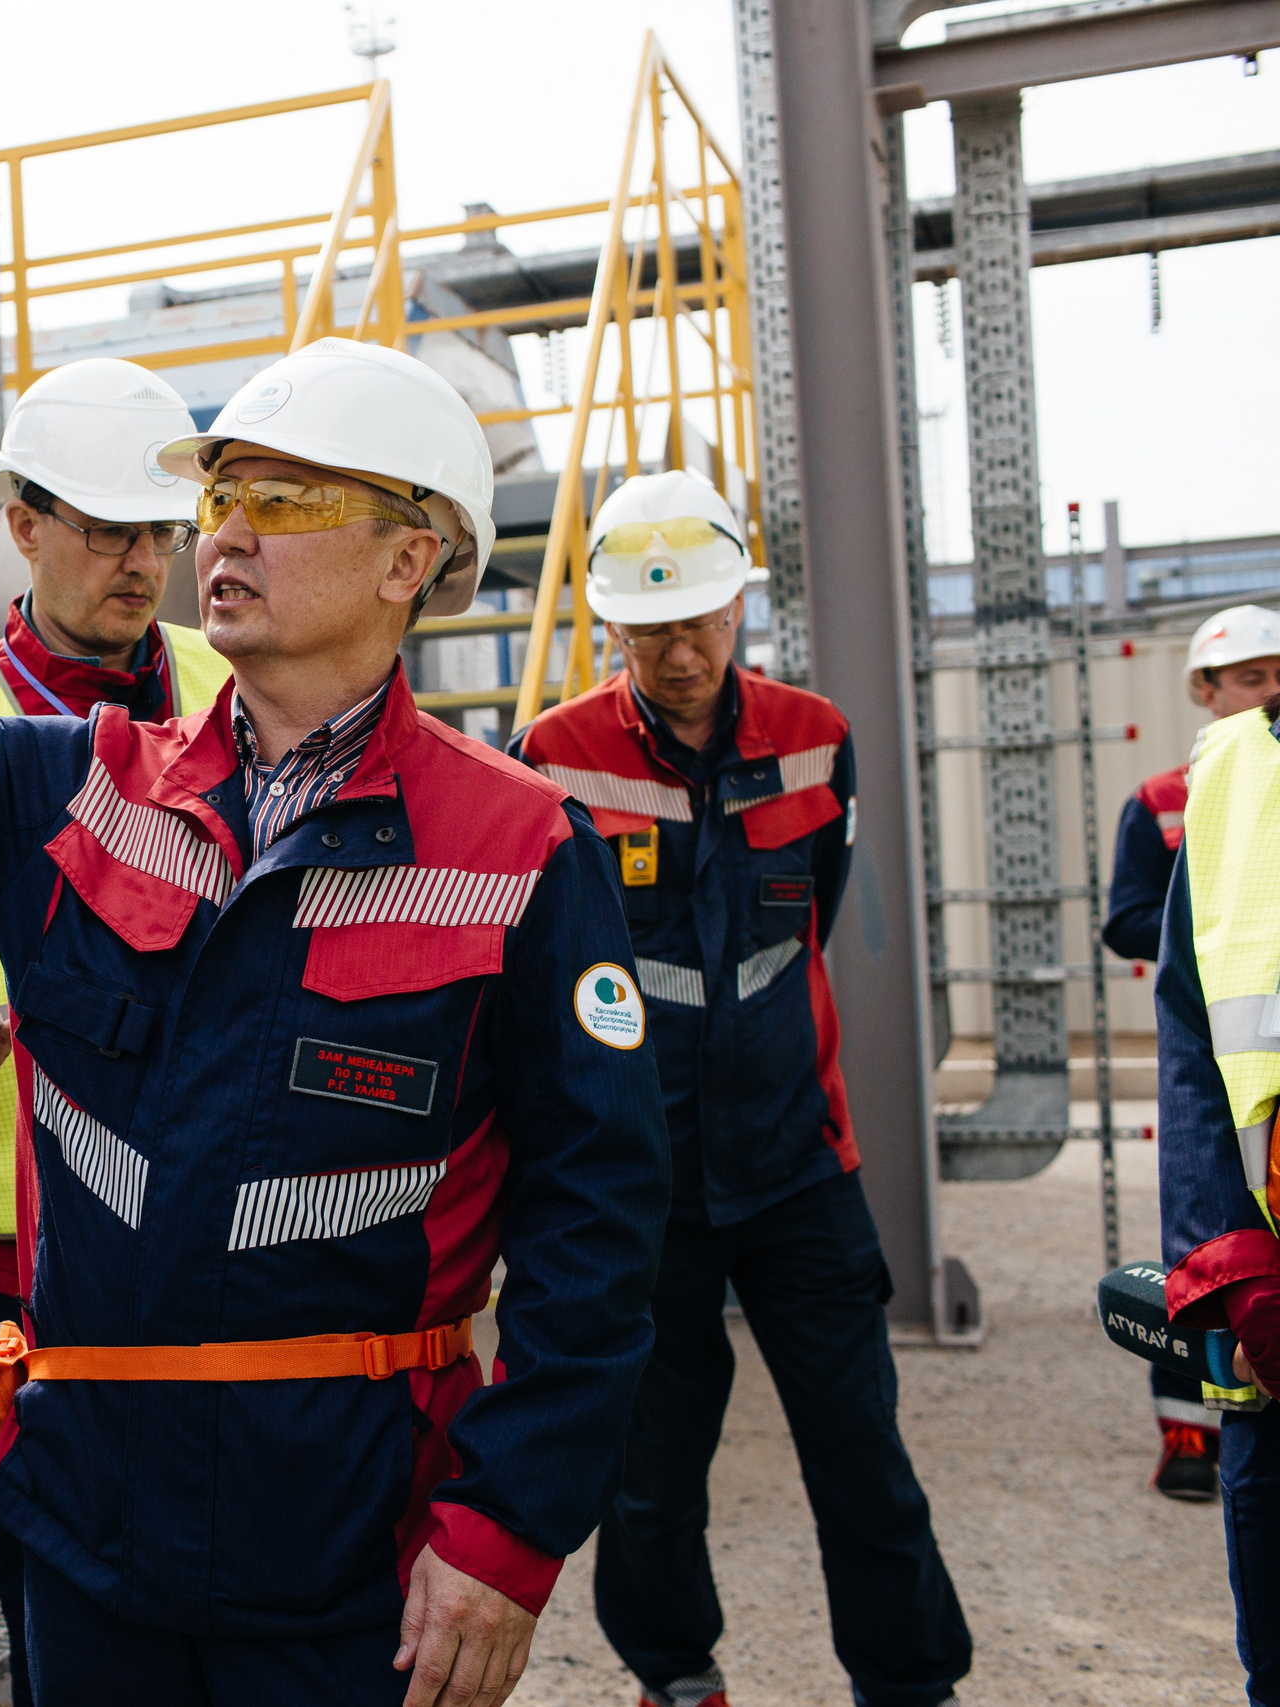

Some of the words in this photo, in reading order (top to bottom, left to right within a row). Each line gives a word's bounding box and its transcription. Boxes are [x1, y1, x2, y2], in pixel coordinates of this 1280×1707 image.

[594, 1006, 632, 1018] Каспийский
[317, 1049, 344, 1064] ЗАМ
[347, 1055, 415, 1078] МЕНЕДЖЕРА
[334, 1066, 351, 1079] ПО
[354, 1070, 364, 1082] Э
[366, 1073, 376, 1084] И
[379, 1075, 393, 1088] ТО
[327, 1078, 348, 1093] Р.Г.
[354, 1083, 396, 1101] УАЛИЕВ
[1124, 1266, 1167, 1287] ATY
